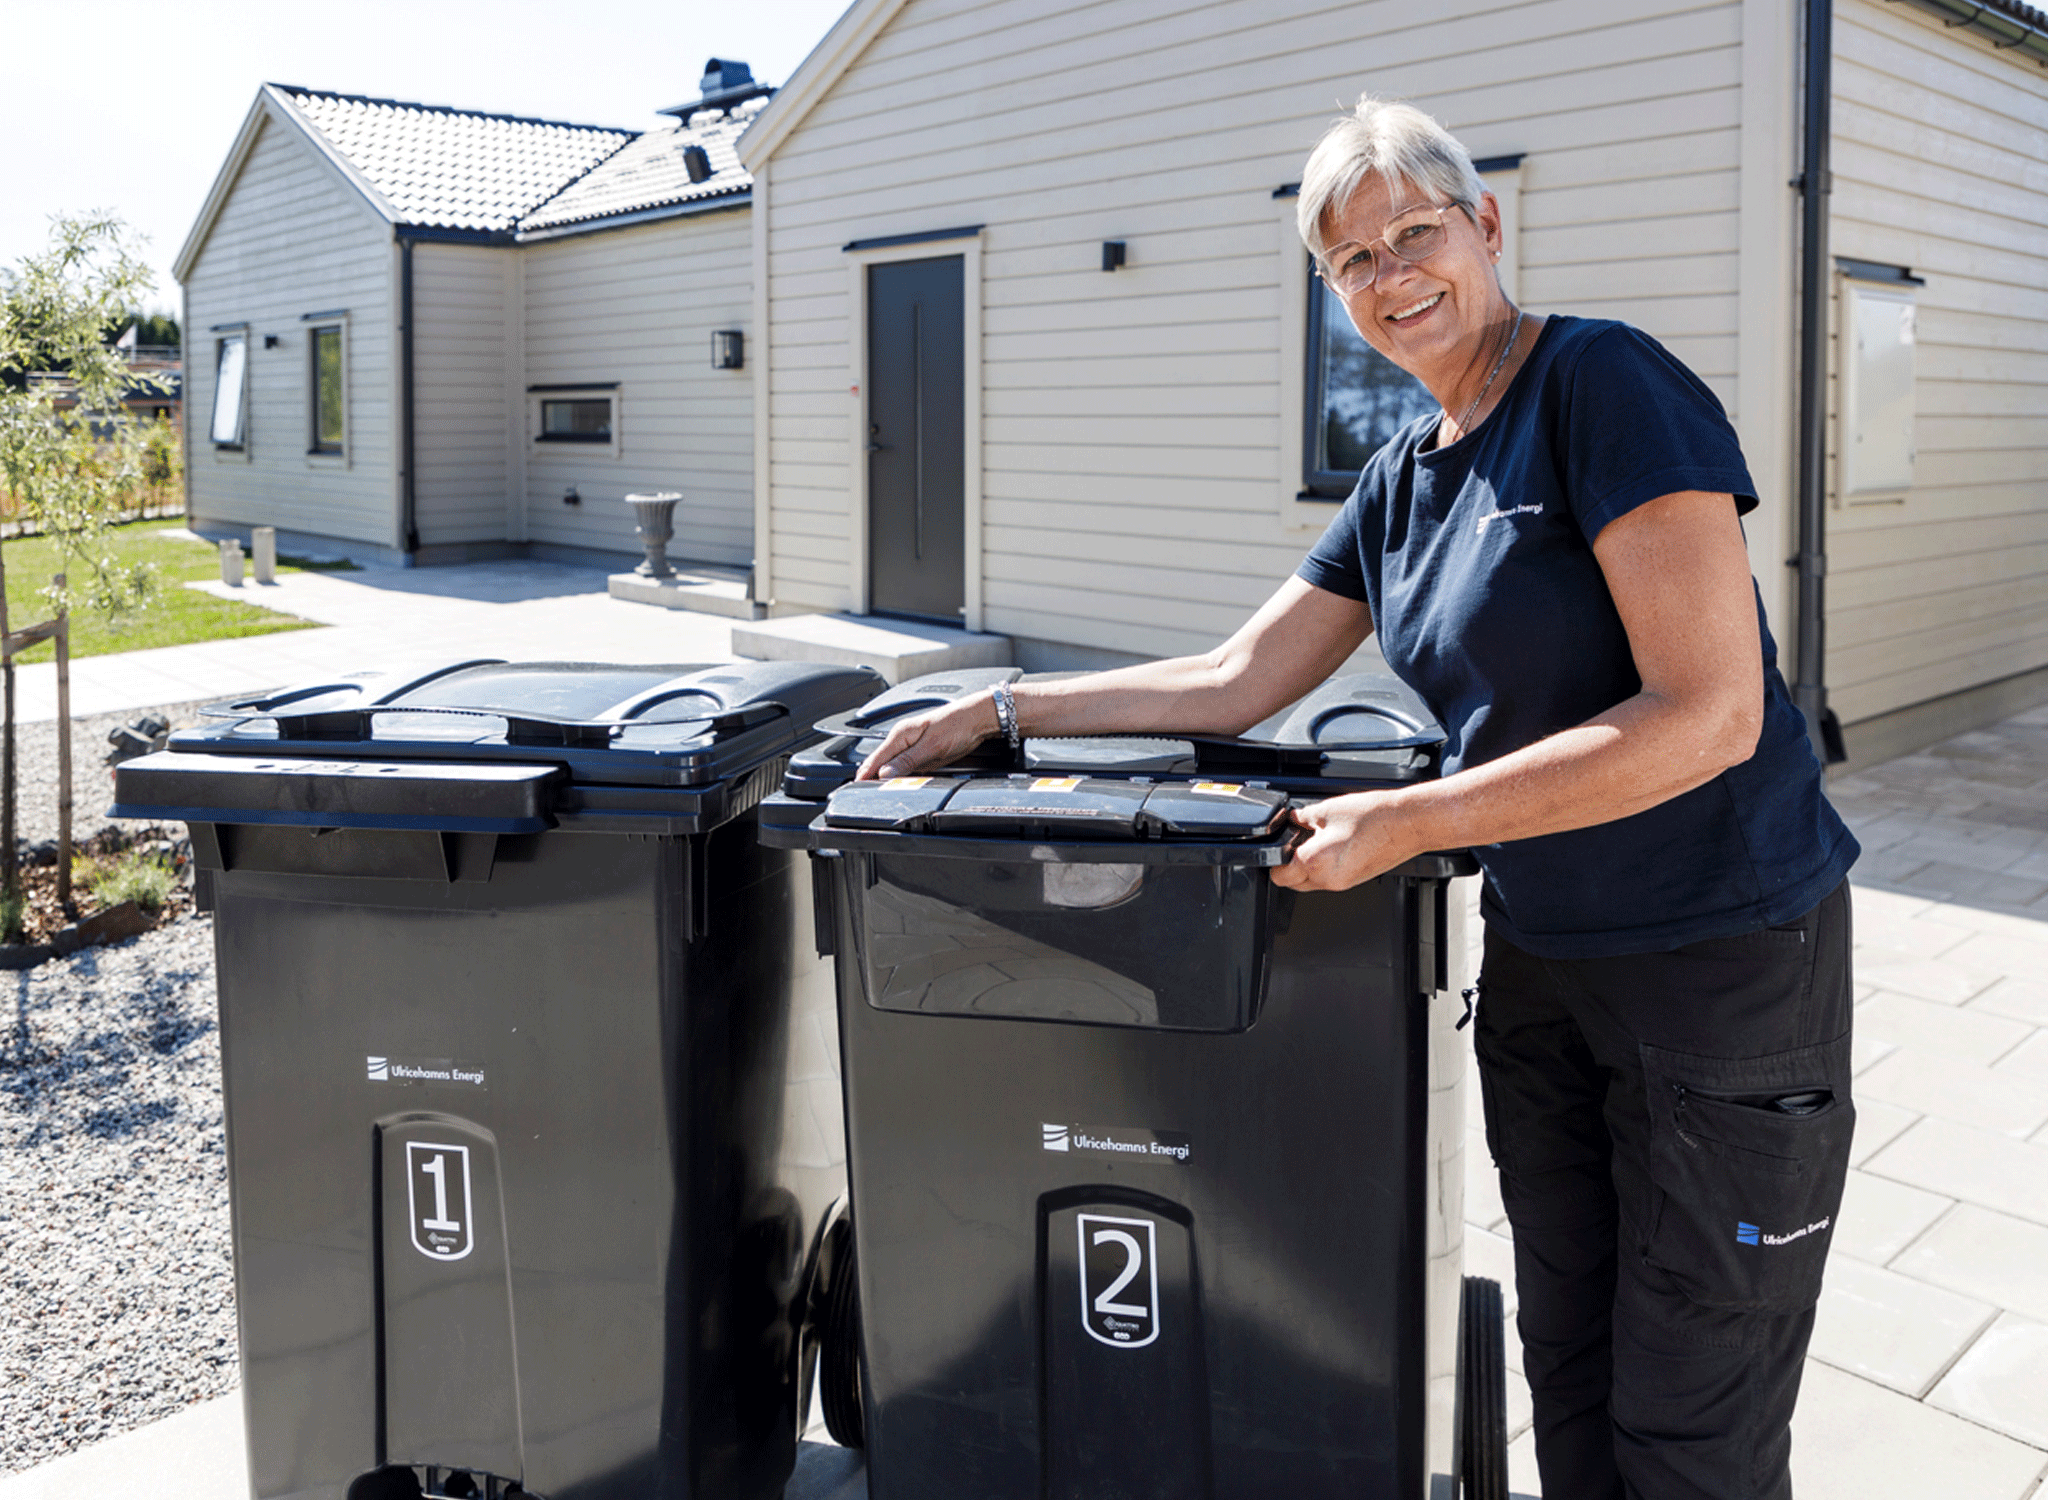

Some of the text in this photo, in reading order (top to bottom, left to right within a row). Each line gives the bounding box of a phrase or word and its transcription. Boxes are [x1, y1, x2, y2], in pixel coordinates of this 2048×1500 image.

[391, 1064, 485, 1085] Ulricehamns Energi
[1073, 1134, 1190, 1160] Ulricehamns Energi
[421, 1153, 460, 1232] 1
[1093, 1229, 1148, 1318] 2
